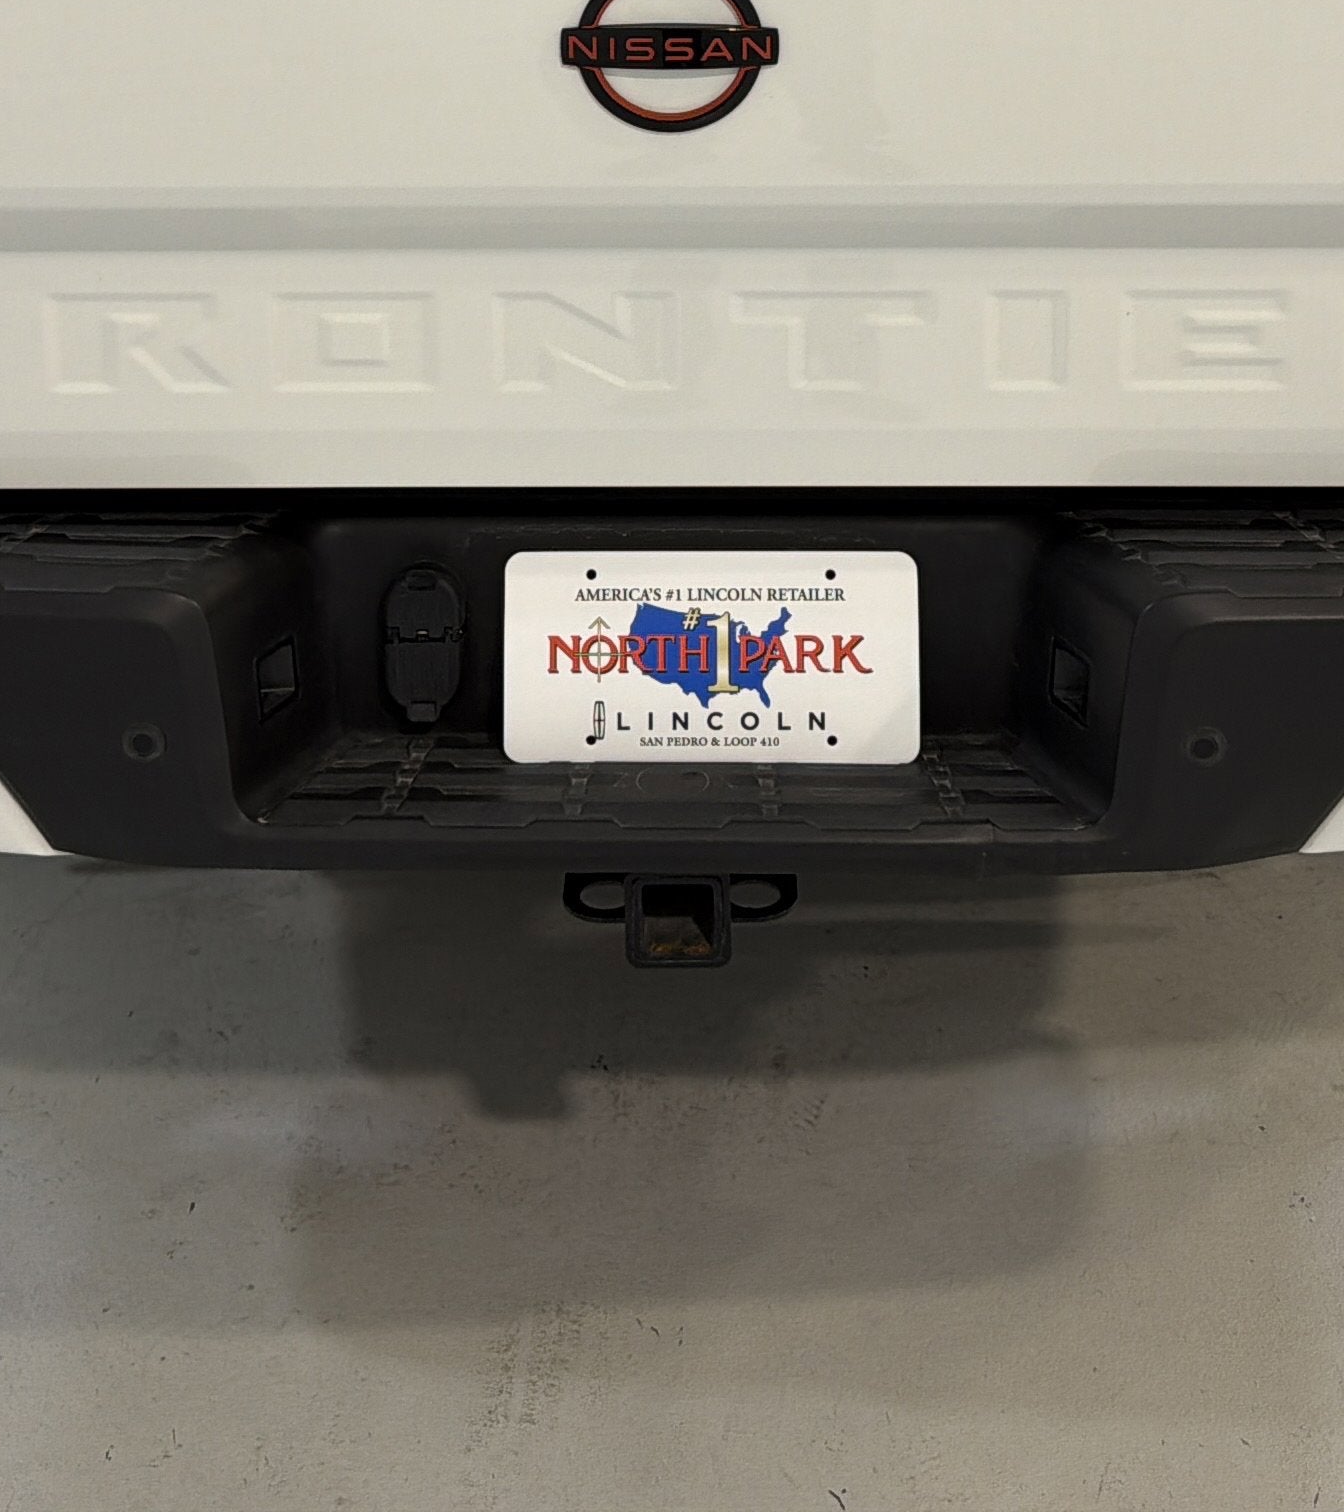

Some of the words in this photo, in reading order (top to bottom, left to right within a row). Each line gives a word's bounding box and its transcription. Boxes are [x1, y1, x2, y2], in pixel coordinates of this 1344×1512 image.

[568, 35, 772, 61] NISSAN
[575, 587, 662, 602] AMERICA'S
[665, 588, 682, 602] #1
[687, 588, 763, 602] LINCOLN
[767, 588, 846, 602] RETAILER
[547, 635, 709, 674] NORTH
[739, 635, 874, 674] PARK
[617, 711, 826, 731] LINCOLN
[639, 737, 665, 747] SAN
[667, 737, 708, 747] PEDRO
[711, 737, 721, 747] &
[724, 737, 757, 747] LOOP
[760, 737, 780, 747] 410
